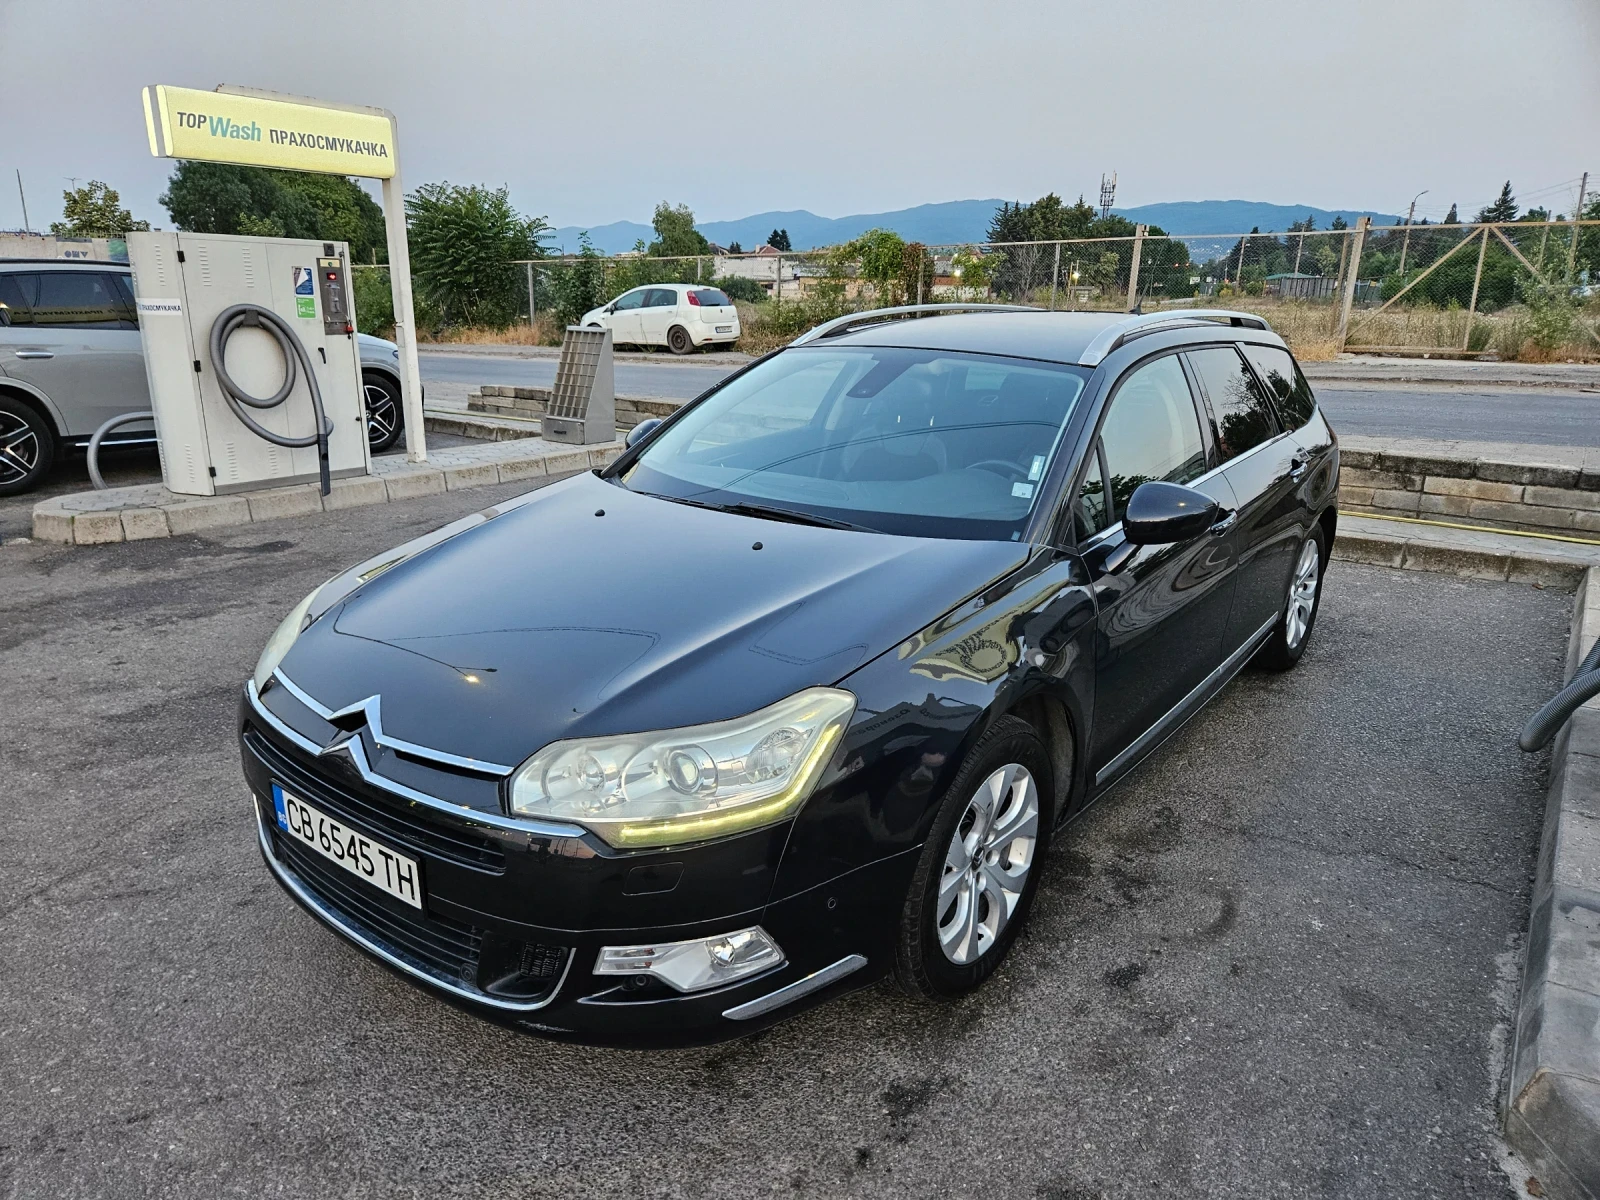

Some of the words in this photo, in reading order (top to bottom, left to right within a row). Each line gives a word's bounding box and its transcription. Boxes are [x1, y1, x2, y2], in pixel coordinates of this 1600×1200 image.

[177, 112, 207, 129] TOP
[209, 116, 262, 142] Wash
[269, 129, 388, 157] ПРАХОСМУКАЧКА
[287, 799, 315, 842] CB
[319, 818, 375, 877] 6545
[378, 848, 416, 901] TH
